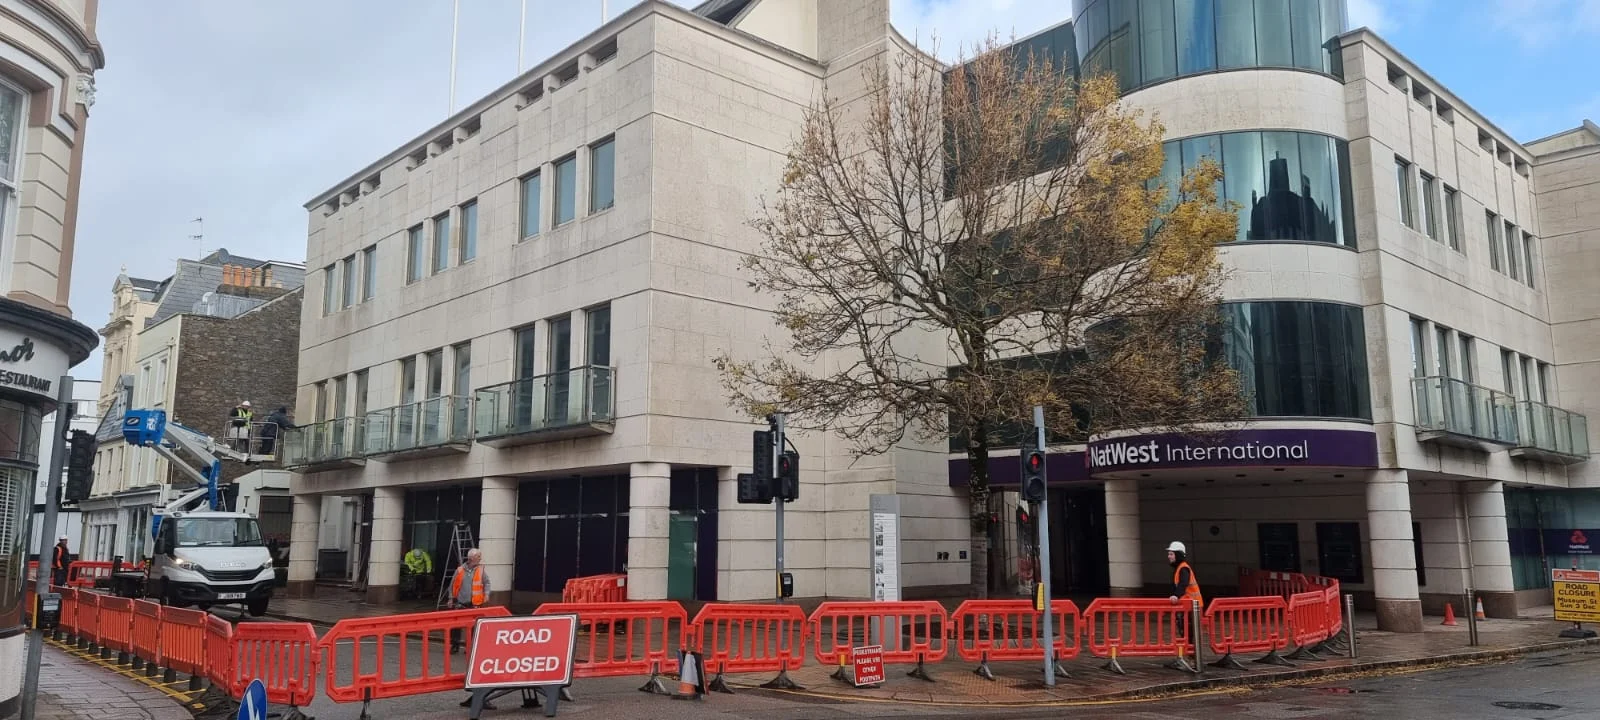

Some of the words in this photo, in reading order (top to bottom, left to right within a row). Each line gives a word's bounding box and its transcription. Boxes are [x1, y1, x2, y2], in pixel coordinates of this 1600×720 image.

[1090, 440, 1160, 467] NatWest
[1166, 440, 1309, 462] International
[1558, 589, 1596, 597] CLOSURE
[495, 628, 552, 645] ROAD
[479, 656, 560, 675] CLOSED
